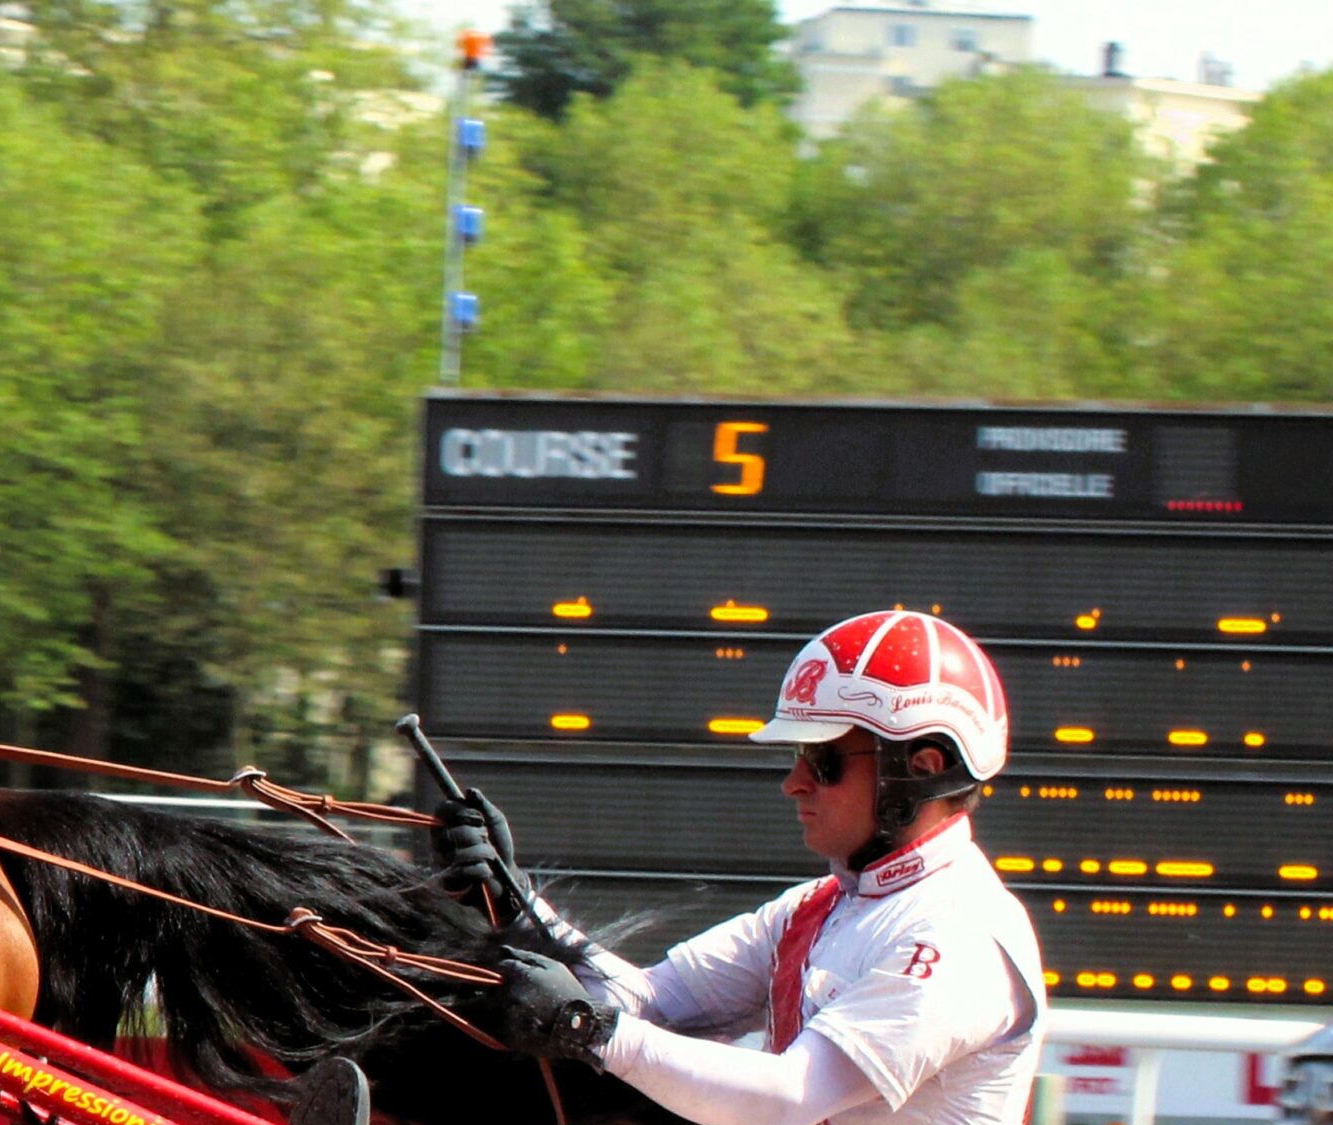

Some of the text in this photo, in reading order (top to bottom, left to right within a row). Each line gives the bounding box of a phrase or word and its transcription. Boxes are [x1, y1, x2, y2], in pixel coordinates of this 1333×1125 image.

[439, 421, 769, 495] COURSE 5
[887, 690, 933, 714] Louis
[902, 943, 941, 979] B
